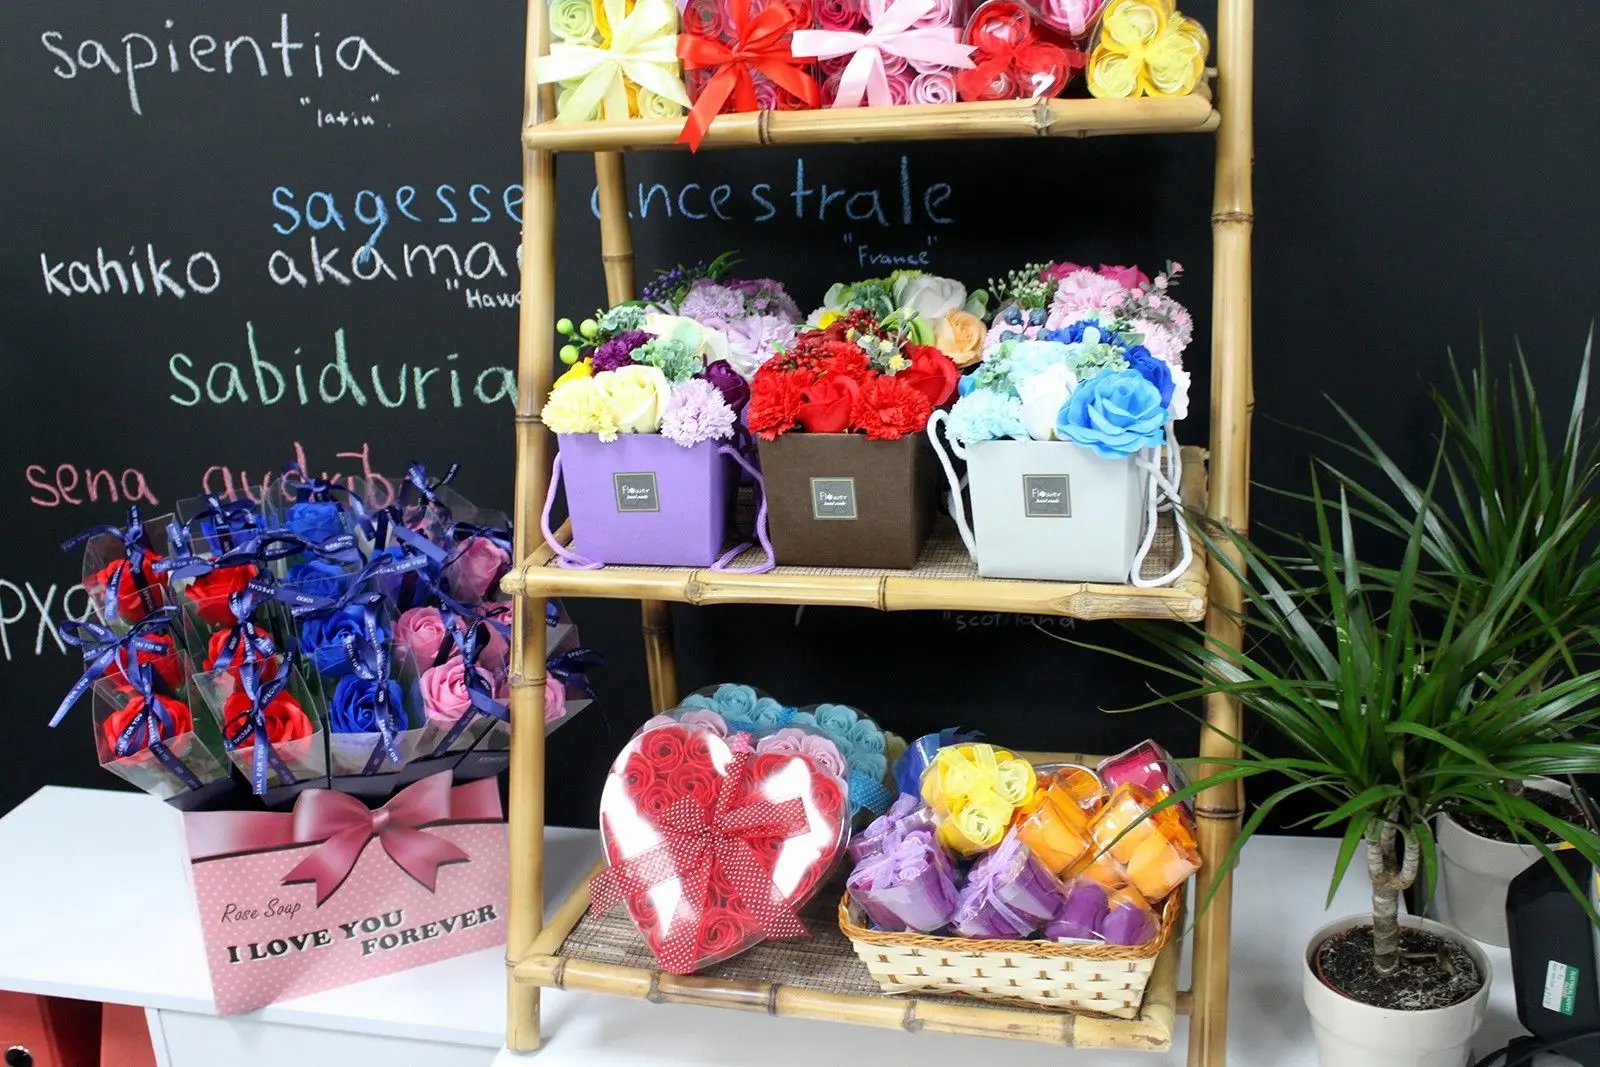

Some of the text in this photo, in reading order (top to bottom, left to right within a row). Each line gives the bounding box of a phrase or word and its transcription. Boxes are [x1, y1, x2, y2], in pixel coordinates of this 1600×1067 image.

[41, 13, 400, 116] sapientia
[271, 184, 523, 262] sagesse
[40, 244, 220, 299] kahiko
[169, 321, 519, 409] sabiduria
[26, 463, 158, 507] sena
[221, 898, 301, 923] Rose Soap
[227, 909, 405, 964] I LOVE YOU
[360, 903, 499, 957] FOREVER
